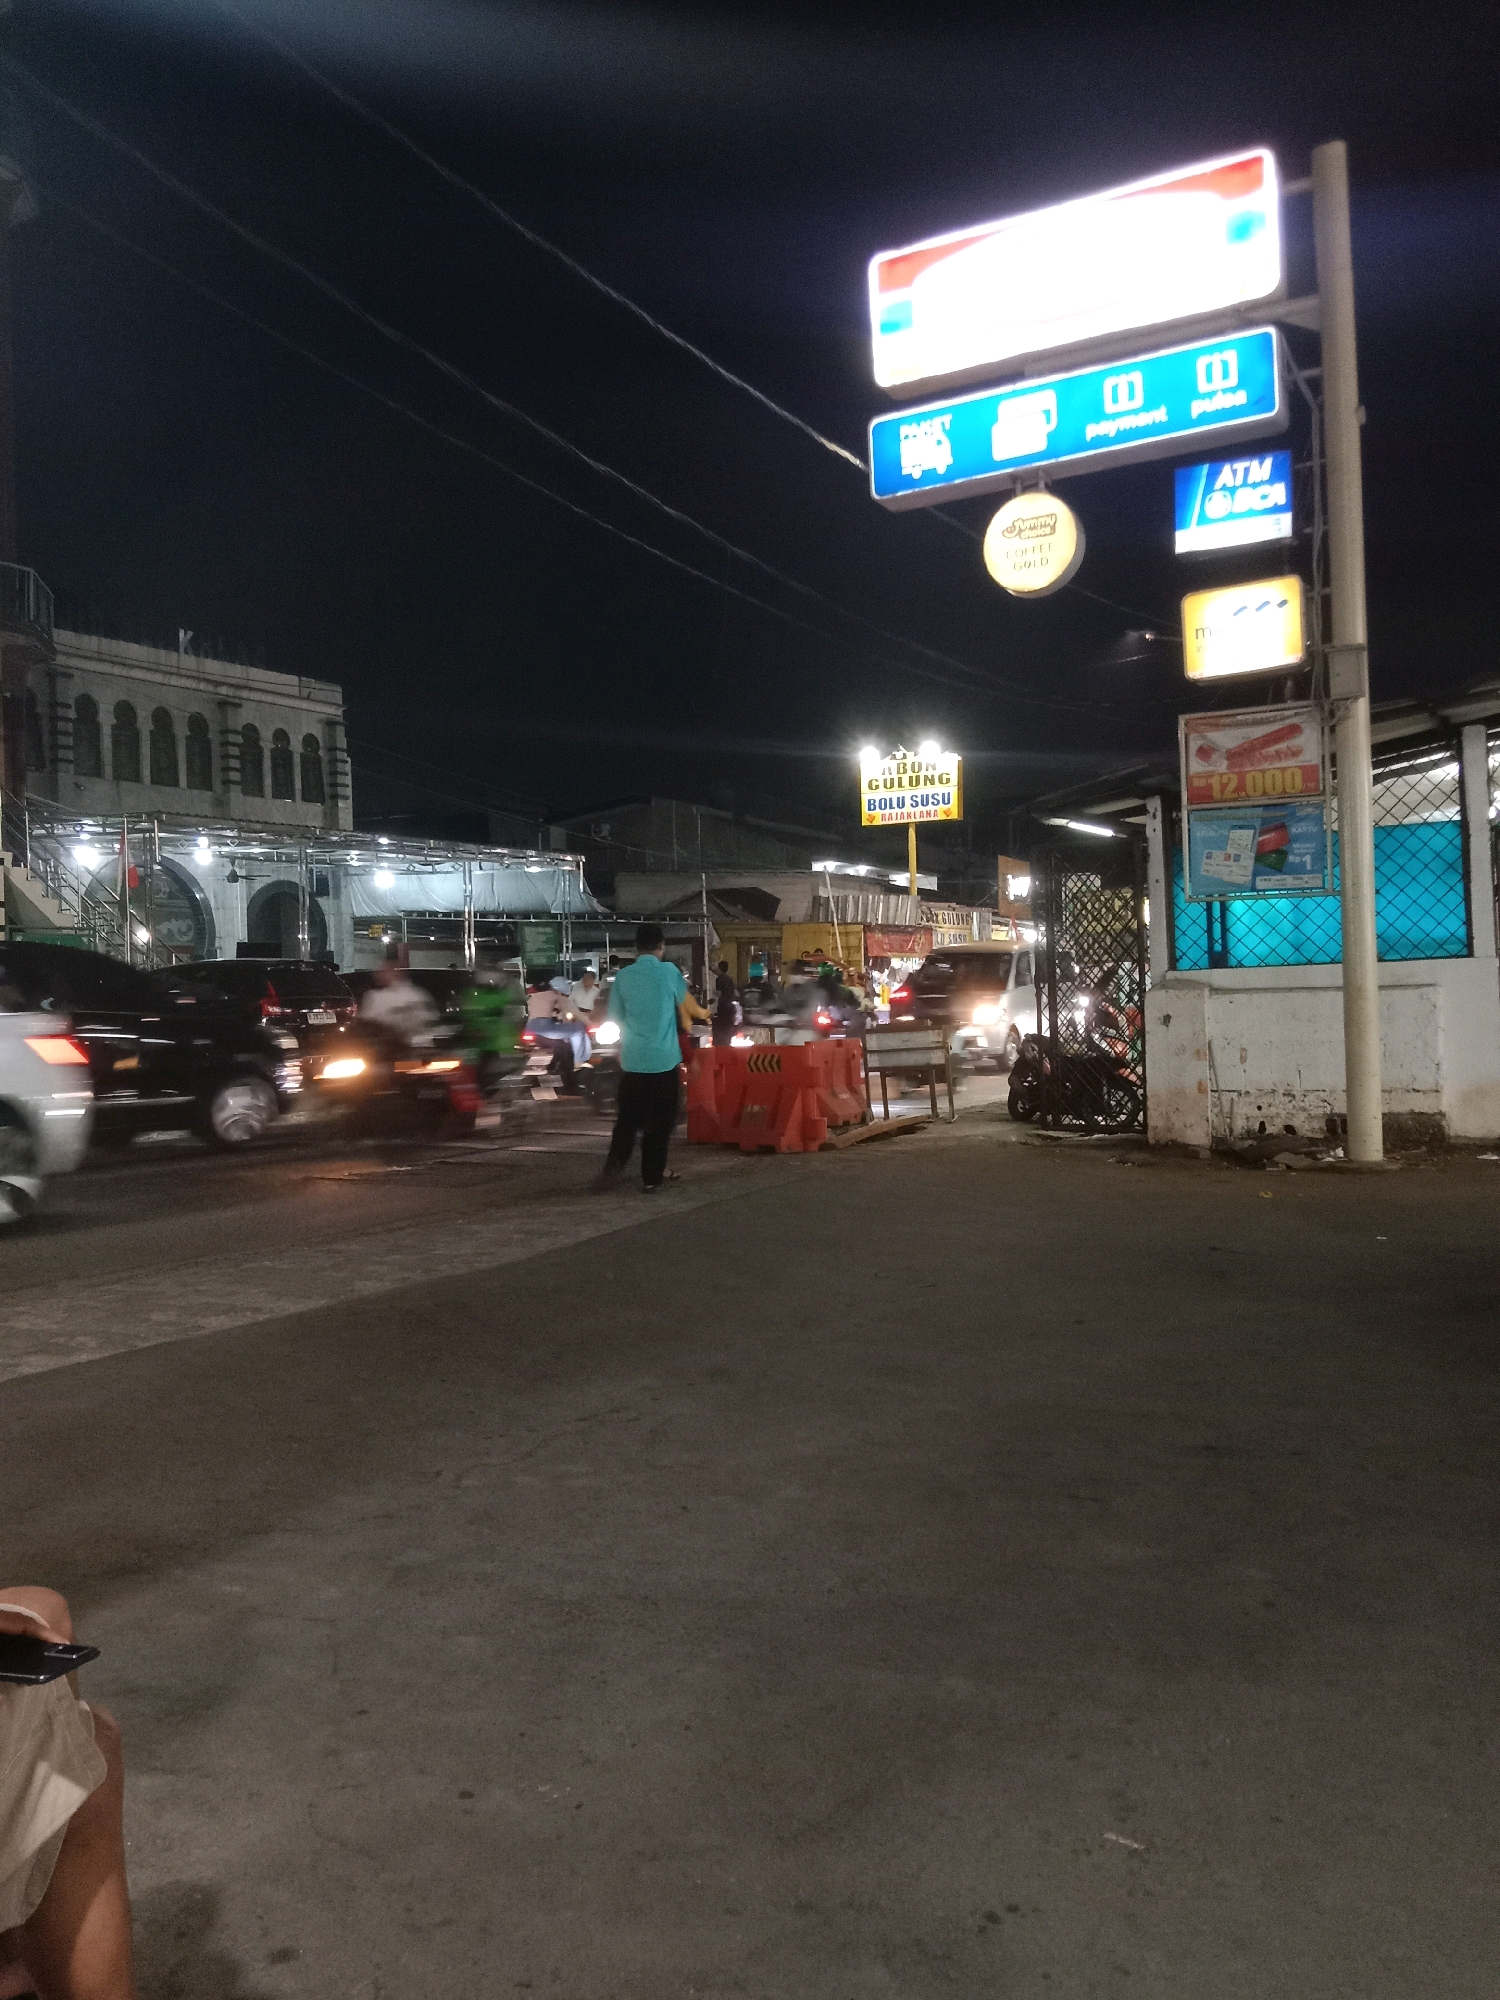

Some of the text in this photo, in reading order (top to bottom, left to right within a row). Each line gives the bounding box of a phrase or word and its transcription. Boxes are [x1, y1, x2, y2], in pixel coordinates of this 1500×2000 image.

[1085, 403, 1169, 442] payment
[1213, 456, 1274, 490] ATM
[1231, 482, 1287, 514] BCA
[1006, 542, 1056, 560] COFFEE
[1013, 556, 1049, 571] GOLD
[867, 772, 952, 791] GULUNG
[1208, 766, 1304, 801] 12.000
[867, 791, 952, 812] BOLU SUSU
[881, 809, 940, 822] RAJAKLANA
[942, 911, 970, 926] GULUNG
